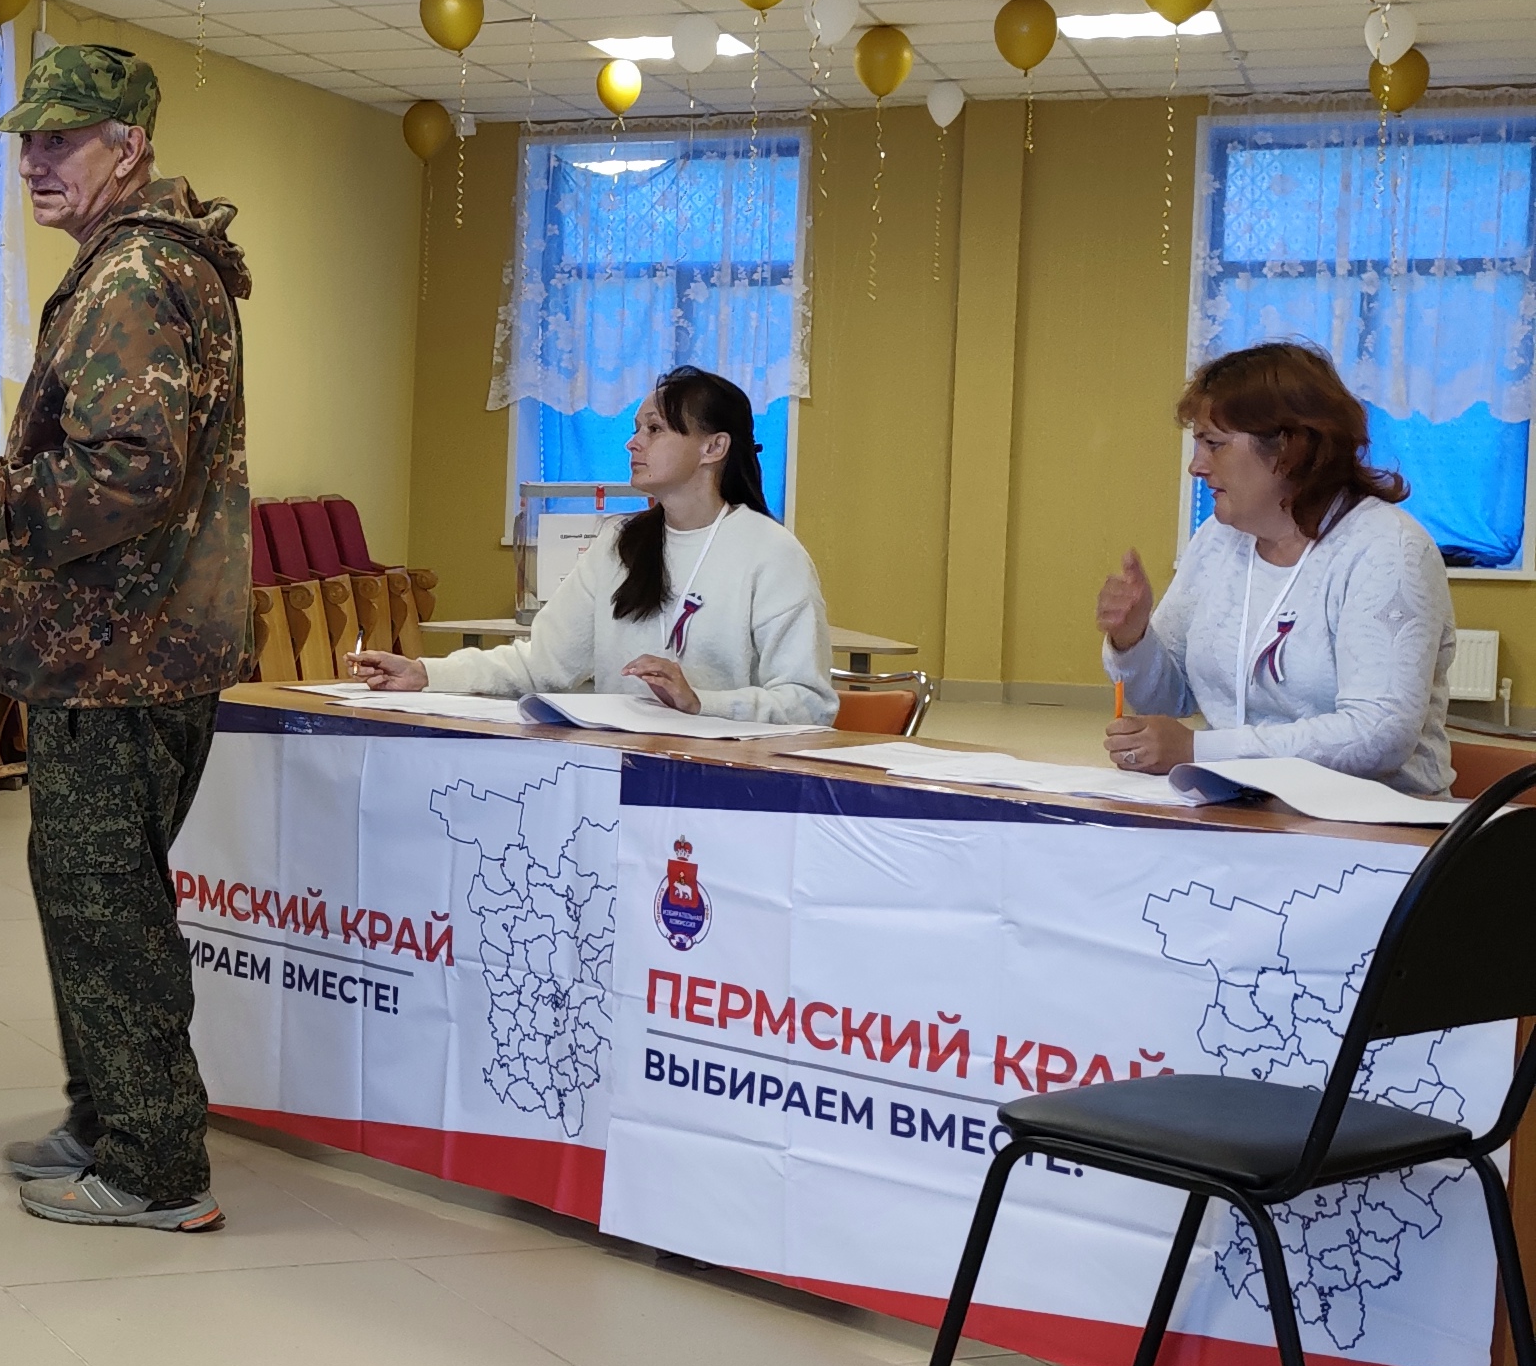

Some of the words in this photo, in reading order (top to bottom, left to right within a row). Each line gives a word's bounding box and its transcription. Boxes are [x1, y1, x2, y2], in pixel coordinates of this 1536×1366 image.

[168, 868, 330, 940] РМСКИЙ
[340, 905, 455, 967] КРАЙ
[183, 937, 271, 985] ИРАЕМ
[282, 960, 400, 1016] ВМЕСТЕ!
[645, 967, 970, 1080] ПЕРМСКИЙ
[644, 1046, 875, 1131] ВЫБИРАЕМ
[889, 1101, 1084, 1178] ВМЕС
